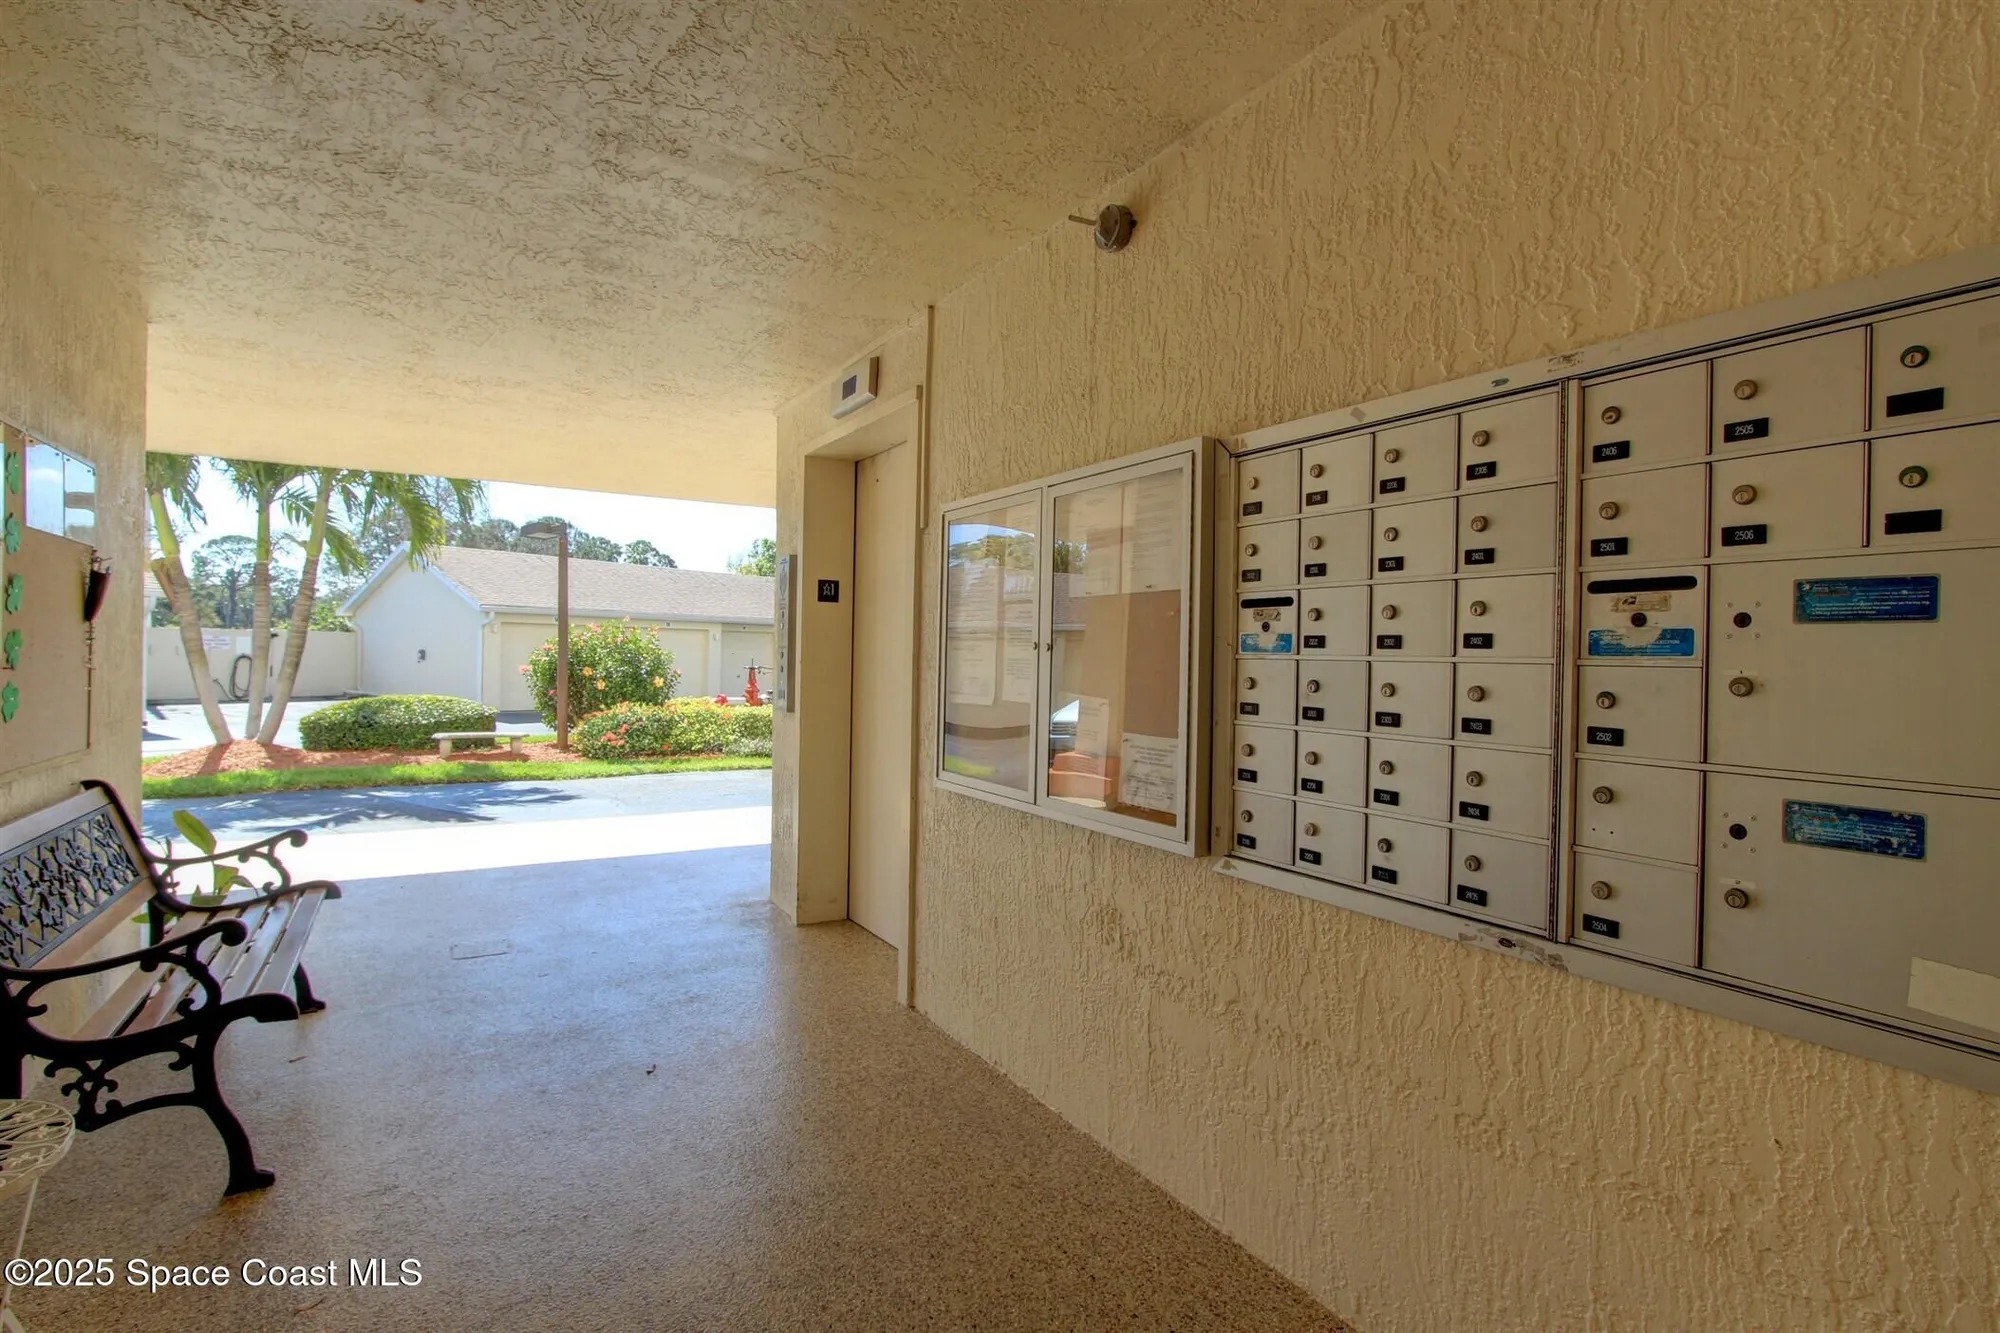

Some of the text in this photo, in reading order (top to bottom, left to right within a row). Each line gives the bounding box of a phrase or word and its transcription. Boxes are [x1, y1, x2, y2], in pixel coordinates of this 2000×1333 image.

[1734, 424, 1754, 436] 2505
[1602, 446, 1618, 457] 2406
[1734, 530, 1754, 540] 2506
[1600, 542, 1616, 552] 2501
[1471, 552, 1484, 561] 2401
[1470, 637, 1483, 645] 2402
[1470, 722, 1483, 731] 2403
[1596, 732, 1613, 742] 2502
[1592, 920, 1608, 932] 2504
